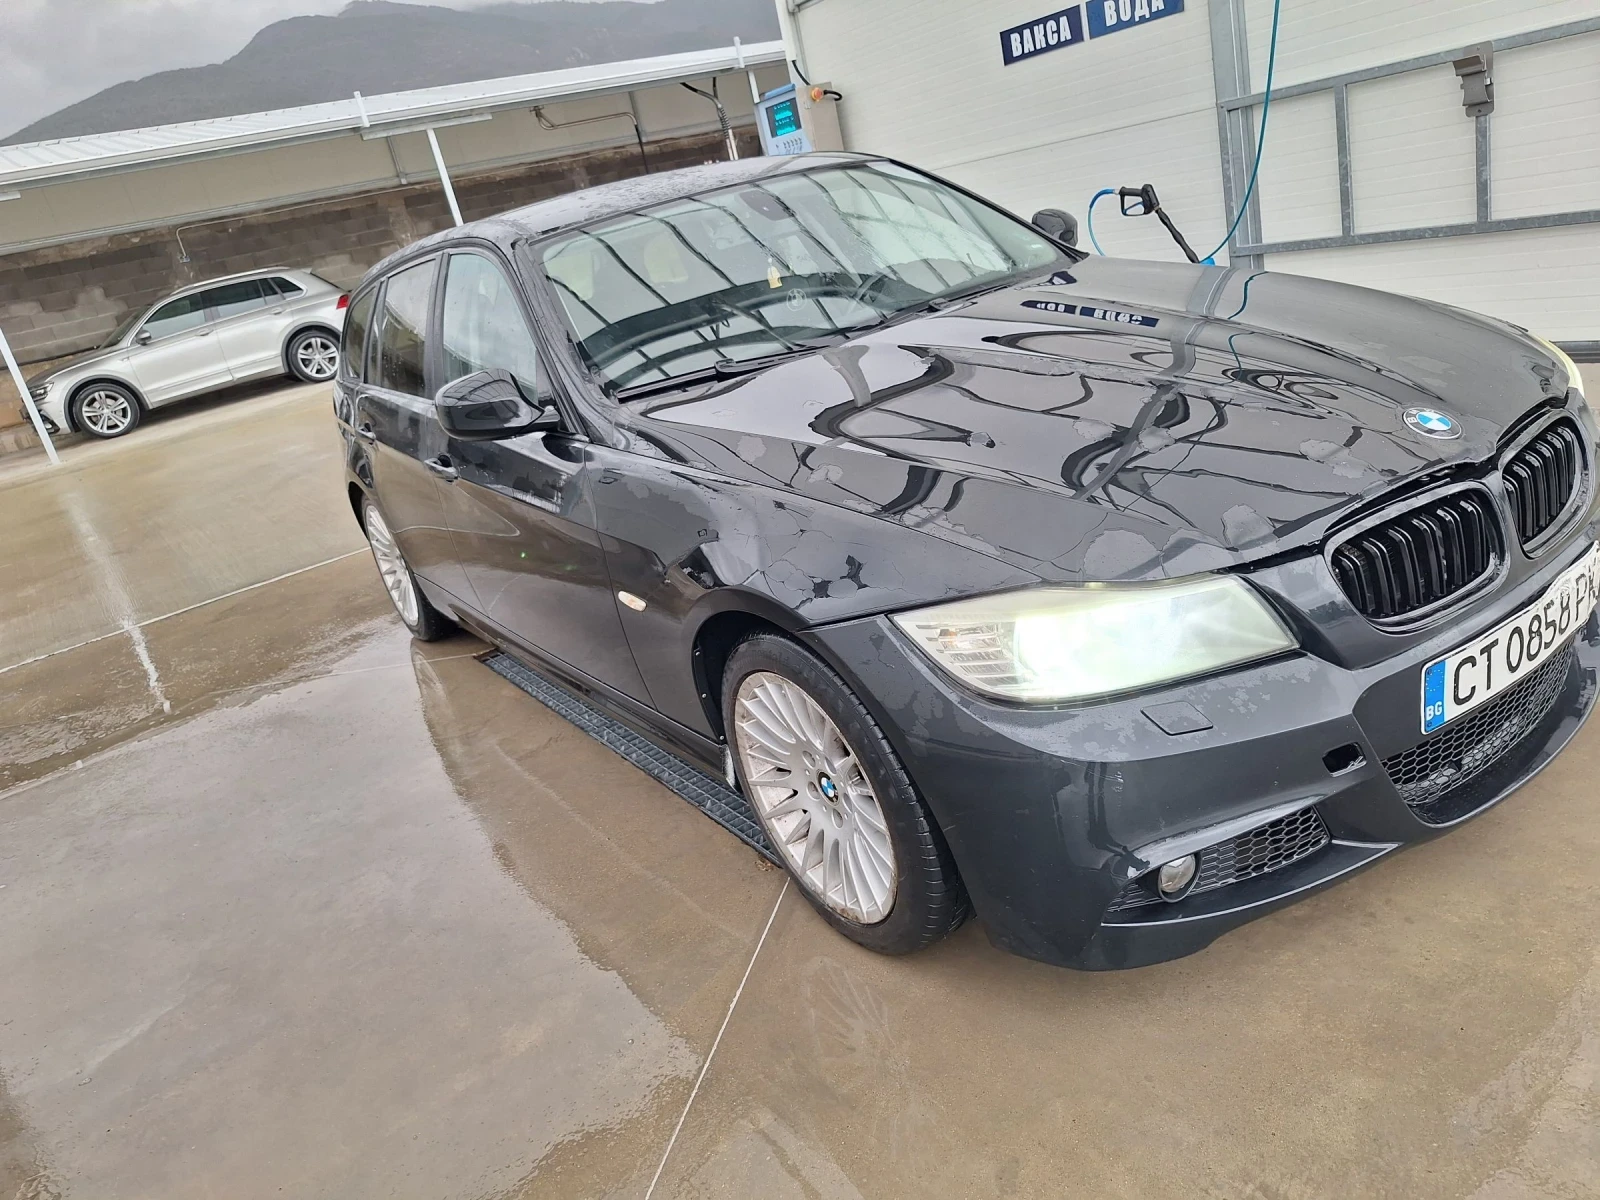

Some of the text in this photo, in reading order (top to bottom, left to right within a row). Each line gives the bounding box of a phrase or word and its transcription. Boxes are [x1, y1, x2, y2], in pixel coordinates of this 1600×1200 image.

[1010, 15, 1072, 58] ВАКСА
[1453, 637, 1499, 706] CT
[1506, 585, 1571, 674] 0858
[1425, 700, 1443, 721] BG
